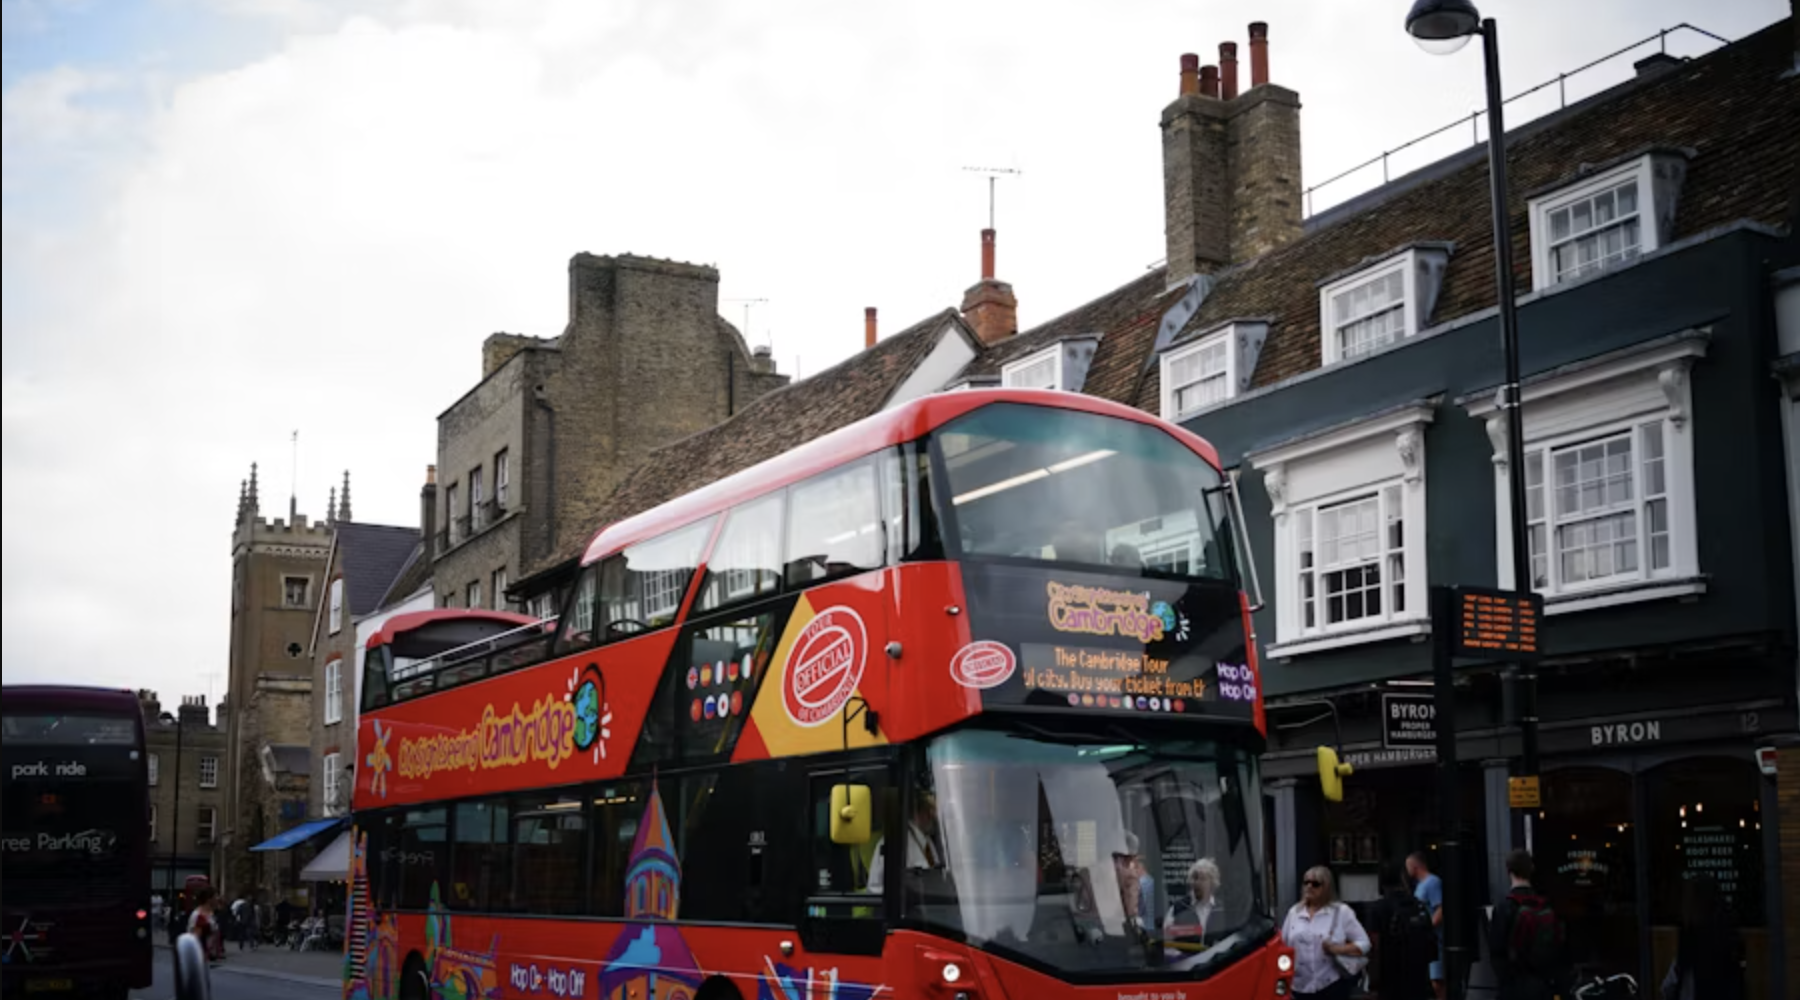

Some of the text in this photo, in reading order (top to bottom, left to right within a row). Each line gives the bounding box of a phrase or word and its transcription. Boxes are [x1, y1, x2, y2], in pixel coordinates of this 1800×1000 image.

[1049, 599, 1164, 643] Cambridge
[797, 640, 851, 690] OFFICIAL
[1054, 646, 1077, 668] The
[1079, 649, 1140, 673] Cambridge
[1216, 662, 1239, 681] Hop
[1219, 681, 1242, 701] Hop
[481, 692, 576, 769] Cambridge
[1590, 720, 1660, 746] BYRON
[1740, 713, 1760, 732] 12
[12, 761, 86, 779] park ride
[2, 832, 102, 854] ree Parking
[510, 963, 528, 991] Hop
[547, 968, 567, 996] Hop
